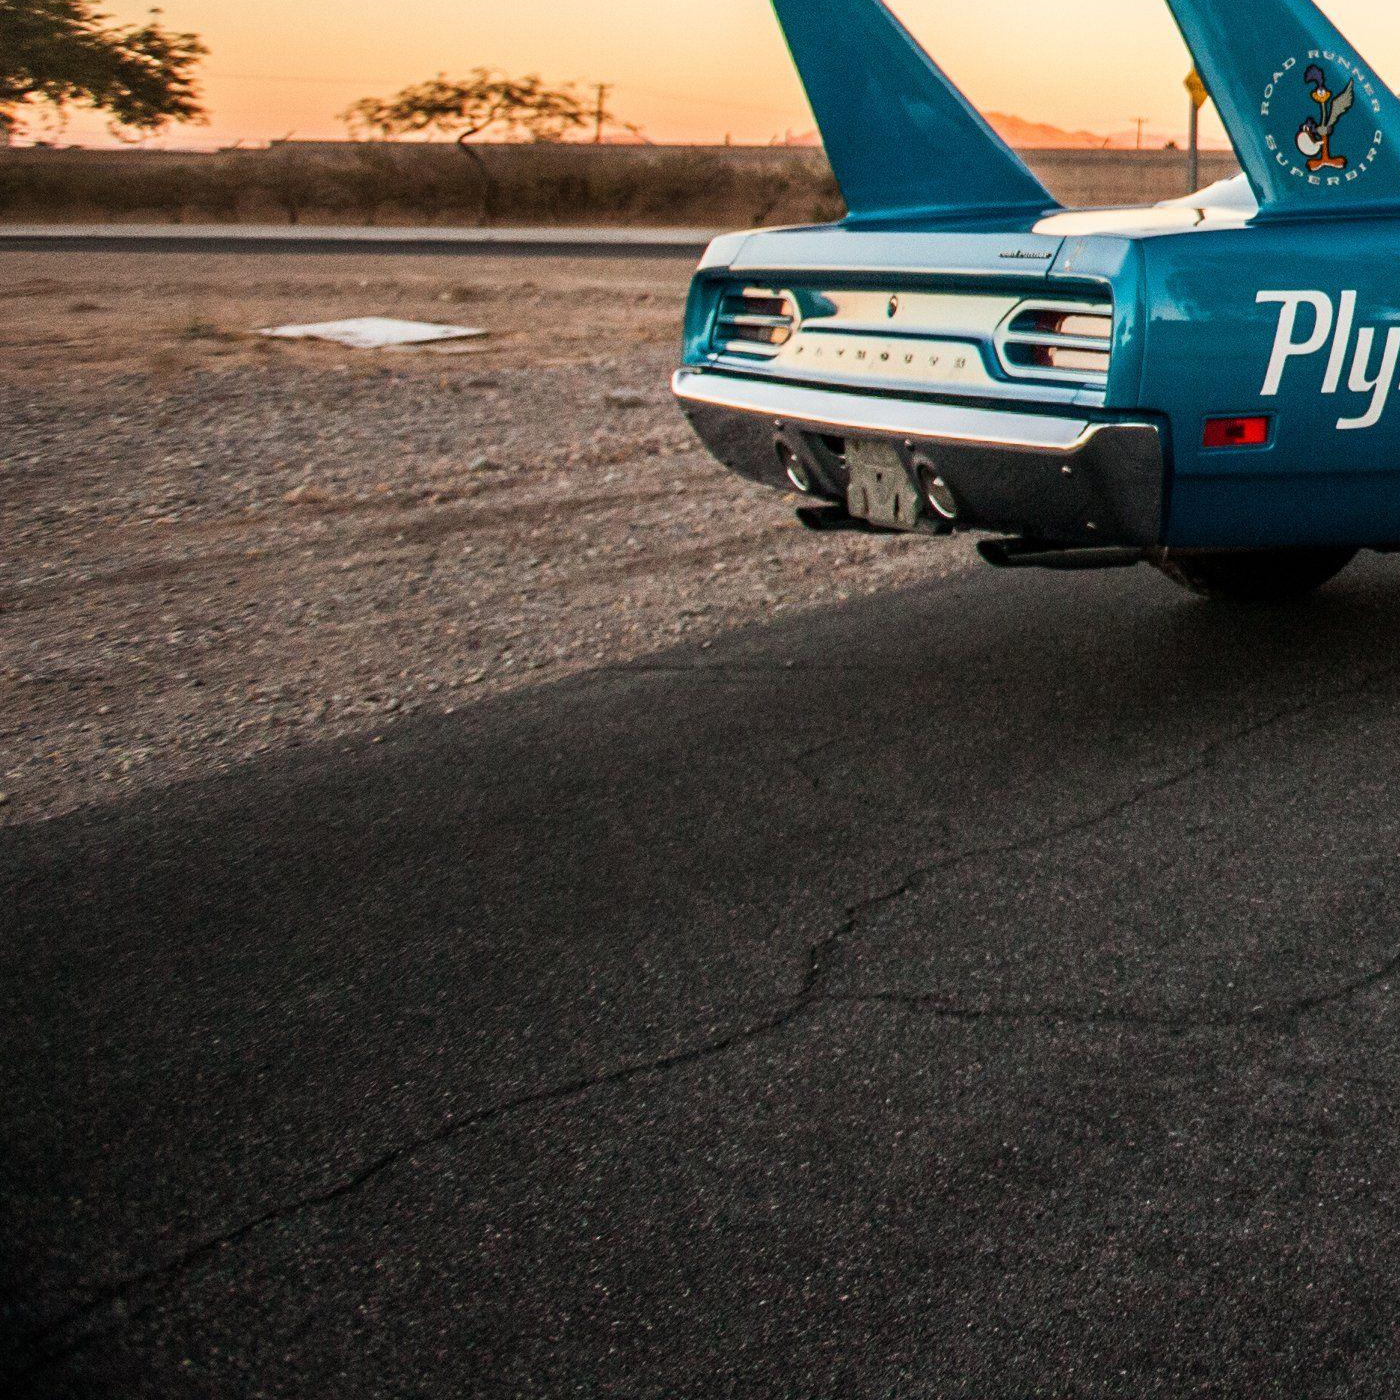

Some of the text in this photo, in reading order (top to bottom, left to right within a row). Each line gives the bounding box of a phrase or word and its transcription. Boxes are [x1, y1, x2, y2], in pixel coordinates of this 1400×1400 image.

[1260, 49, 1380, 116] ROAD RUNNER
[1265, 130, 1382, 186] SUPERBIRD
